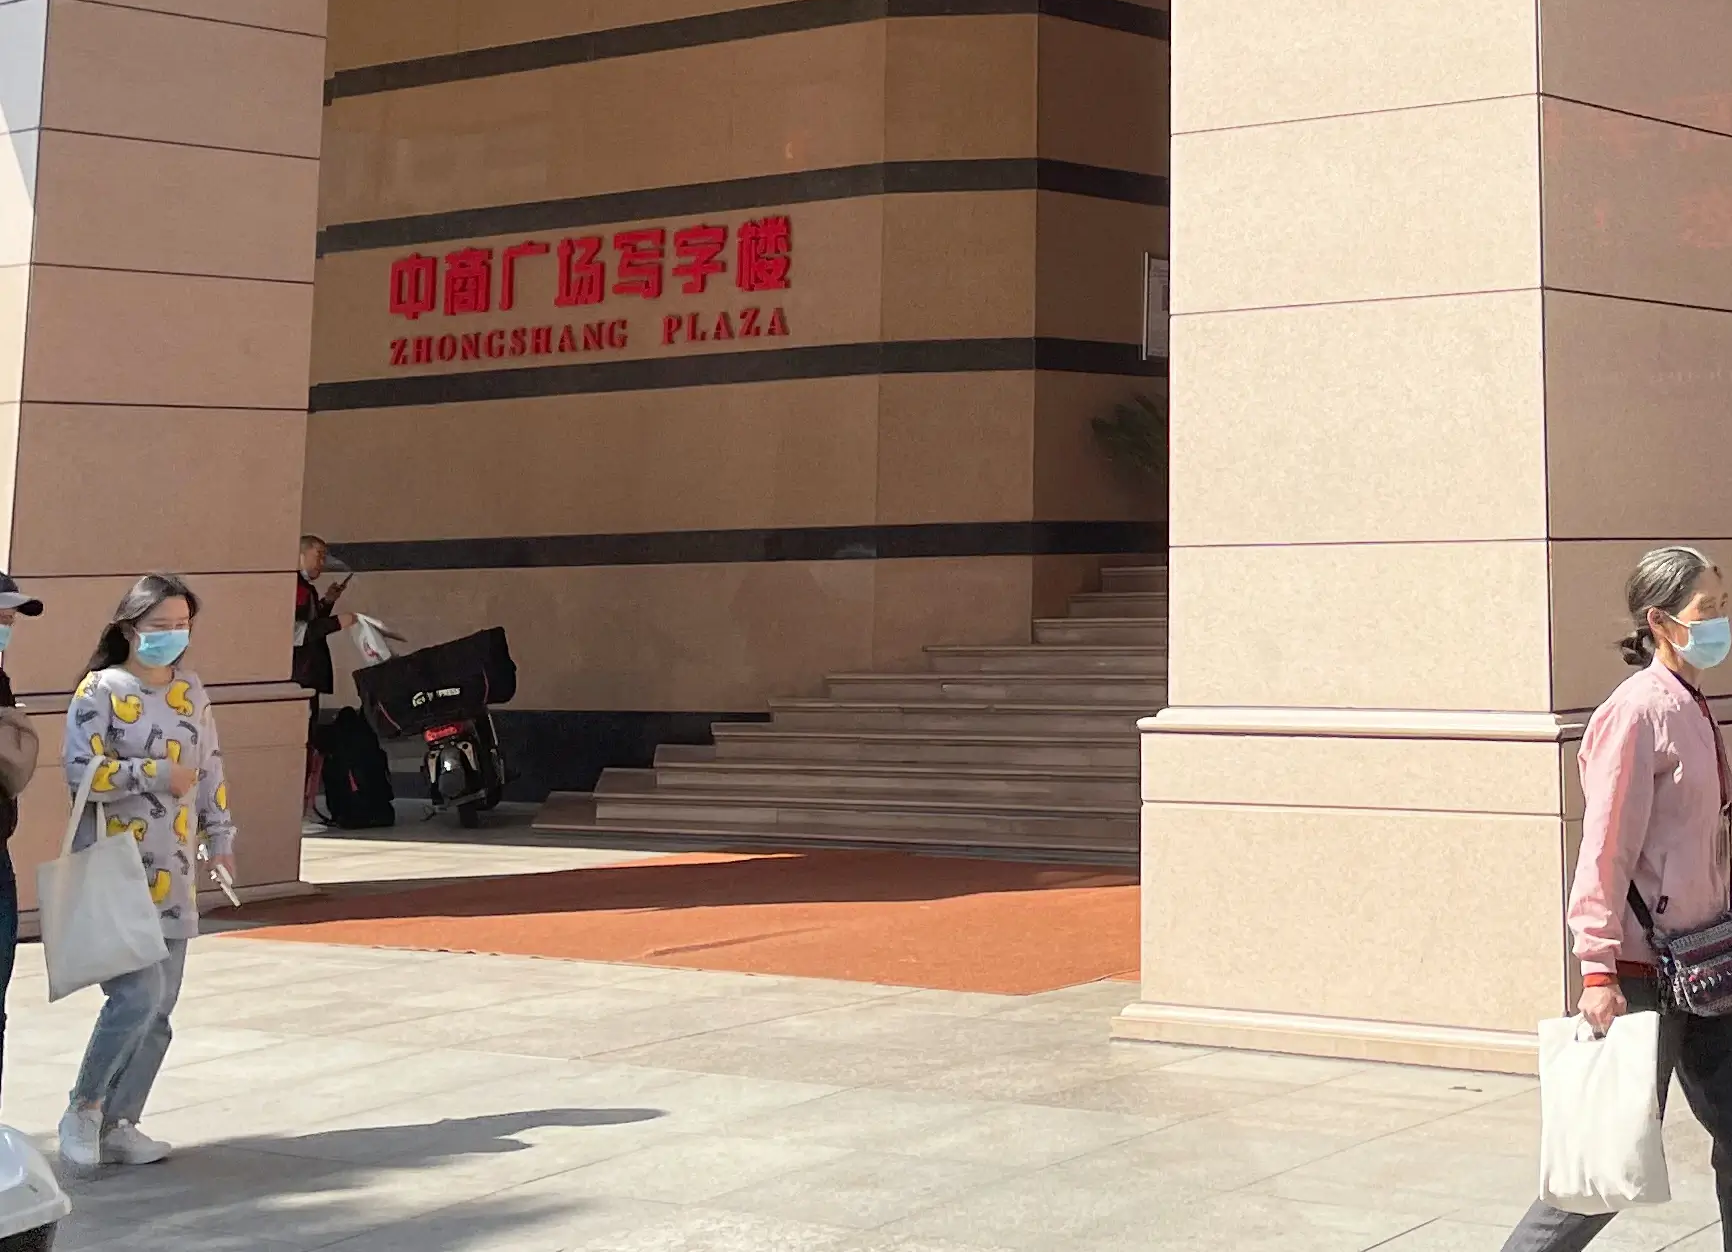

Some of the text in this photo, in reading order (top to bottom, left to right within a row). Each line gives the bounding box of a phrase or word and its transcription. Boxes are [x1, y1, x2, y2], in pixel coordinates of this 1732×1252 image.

[388, 215, 793, 320] 中商广场写字楼
[389, 307, 790, 366] ZHONGSHANG PLAZA
